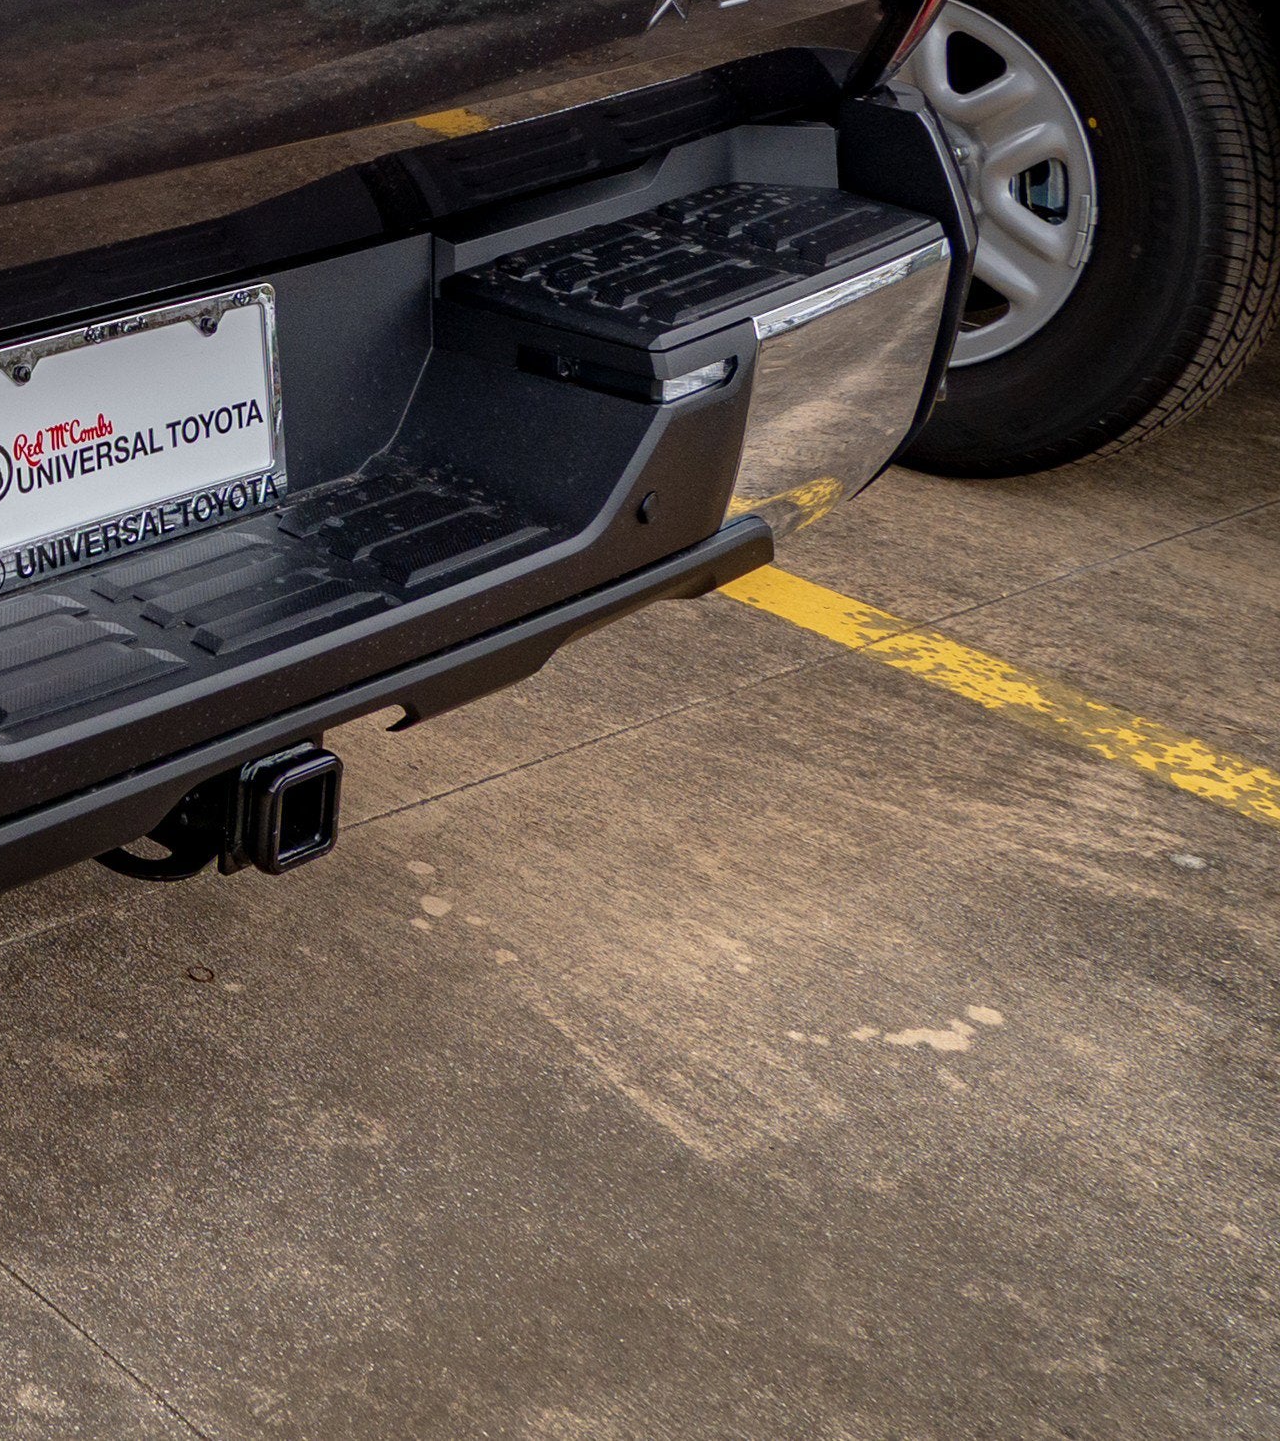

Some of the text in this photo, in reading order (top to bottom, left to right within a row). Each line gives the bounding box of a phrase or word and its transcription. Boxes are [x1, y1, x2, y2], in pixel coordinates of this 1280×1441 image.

[12, 432, 45, 467] Red
[15, 398, 264, 494] UNIVERSAL TOYOTA
[14, 472, 280, 579] UNIVERSAL TOYOTA
